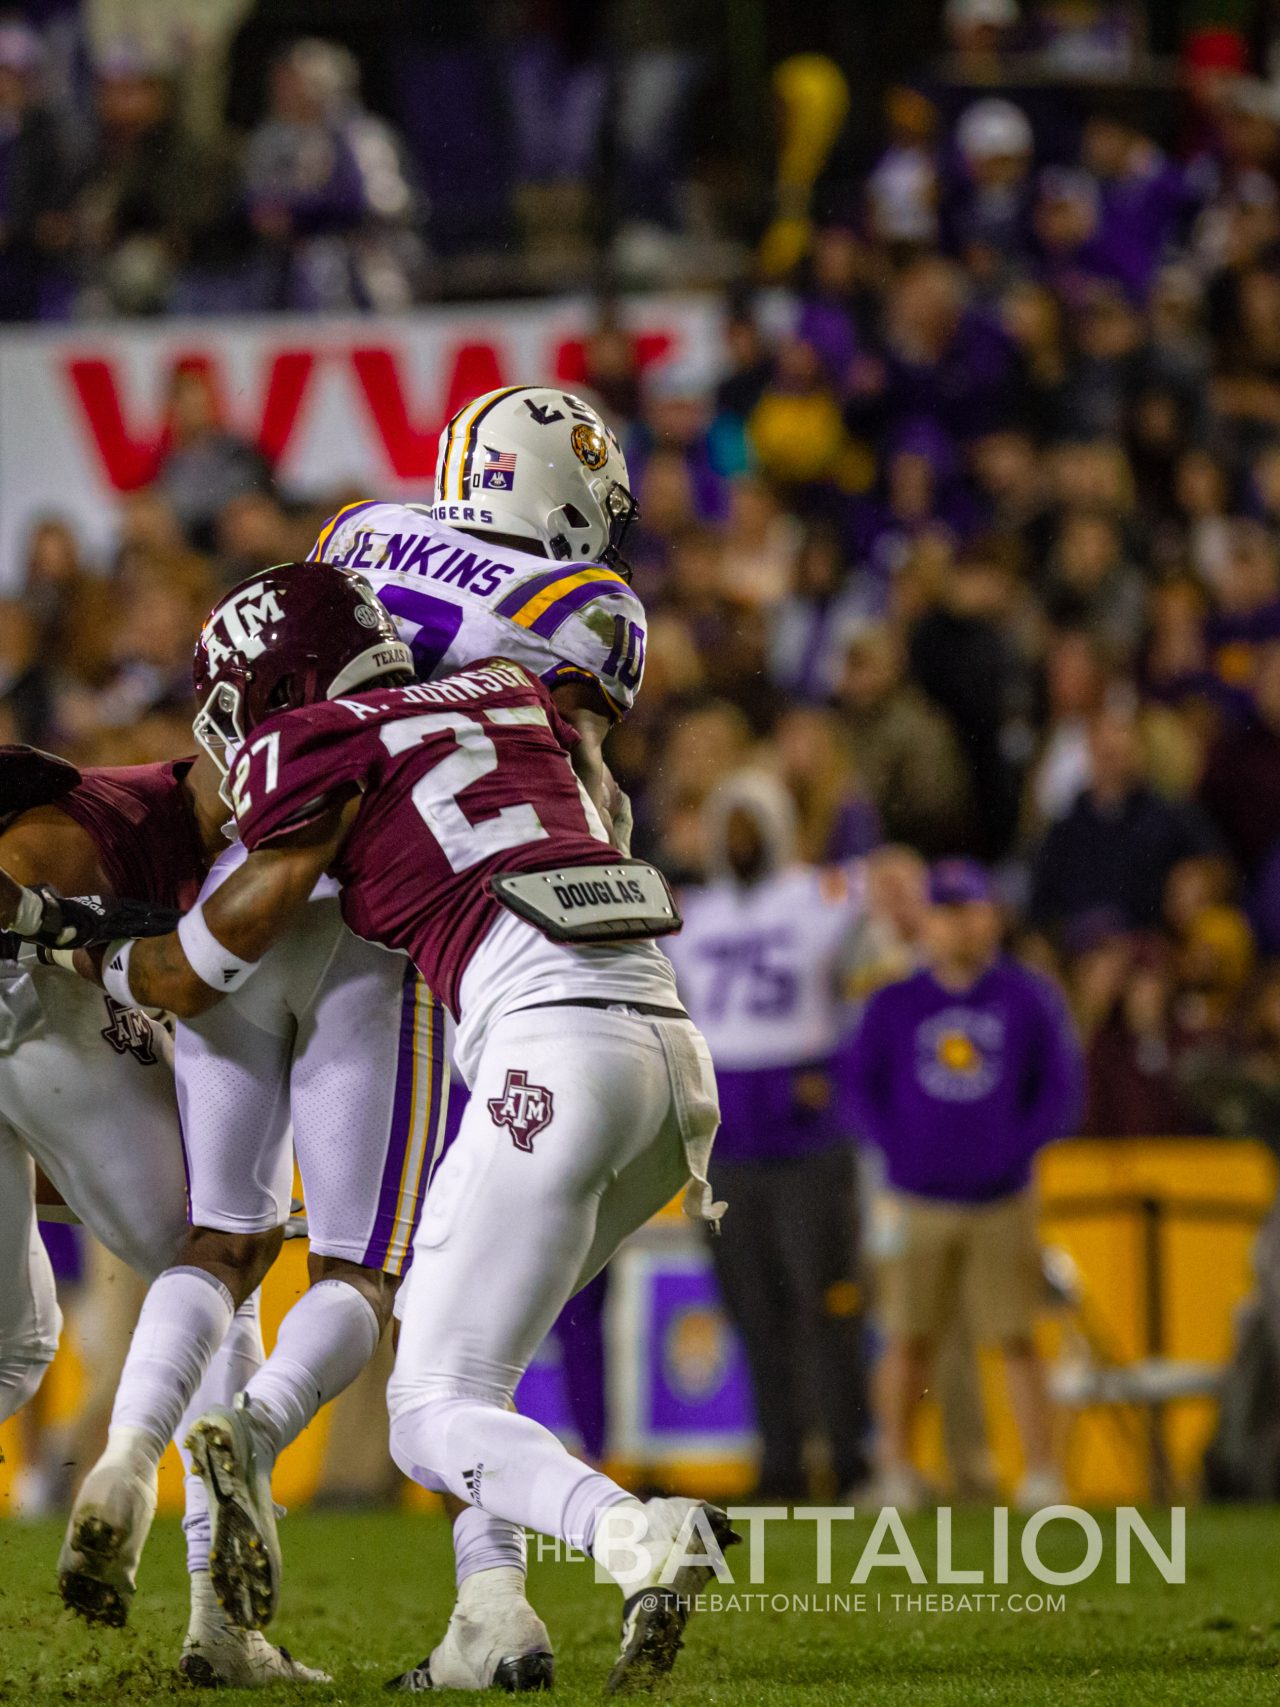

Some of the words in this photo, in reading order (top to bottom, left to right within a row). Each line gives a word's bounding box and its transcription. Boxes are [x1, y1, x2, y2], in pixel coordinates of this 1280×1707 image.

[431, 506, 493, 524] IGERS
[332, 529, 515, 598] JENKINS
[372, 649, 406, 667] TEXAS
[600, 613, 645, 690] 10
[334, 693, 390, 721] A.
[231, 731, 281, 820] 27
[552, 879, 646, 910] DOUGLAS
